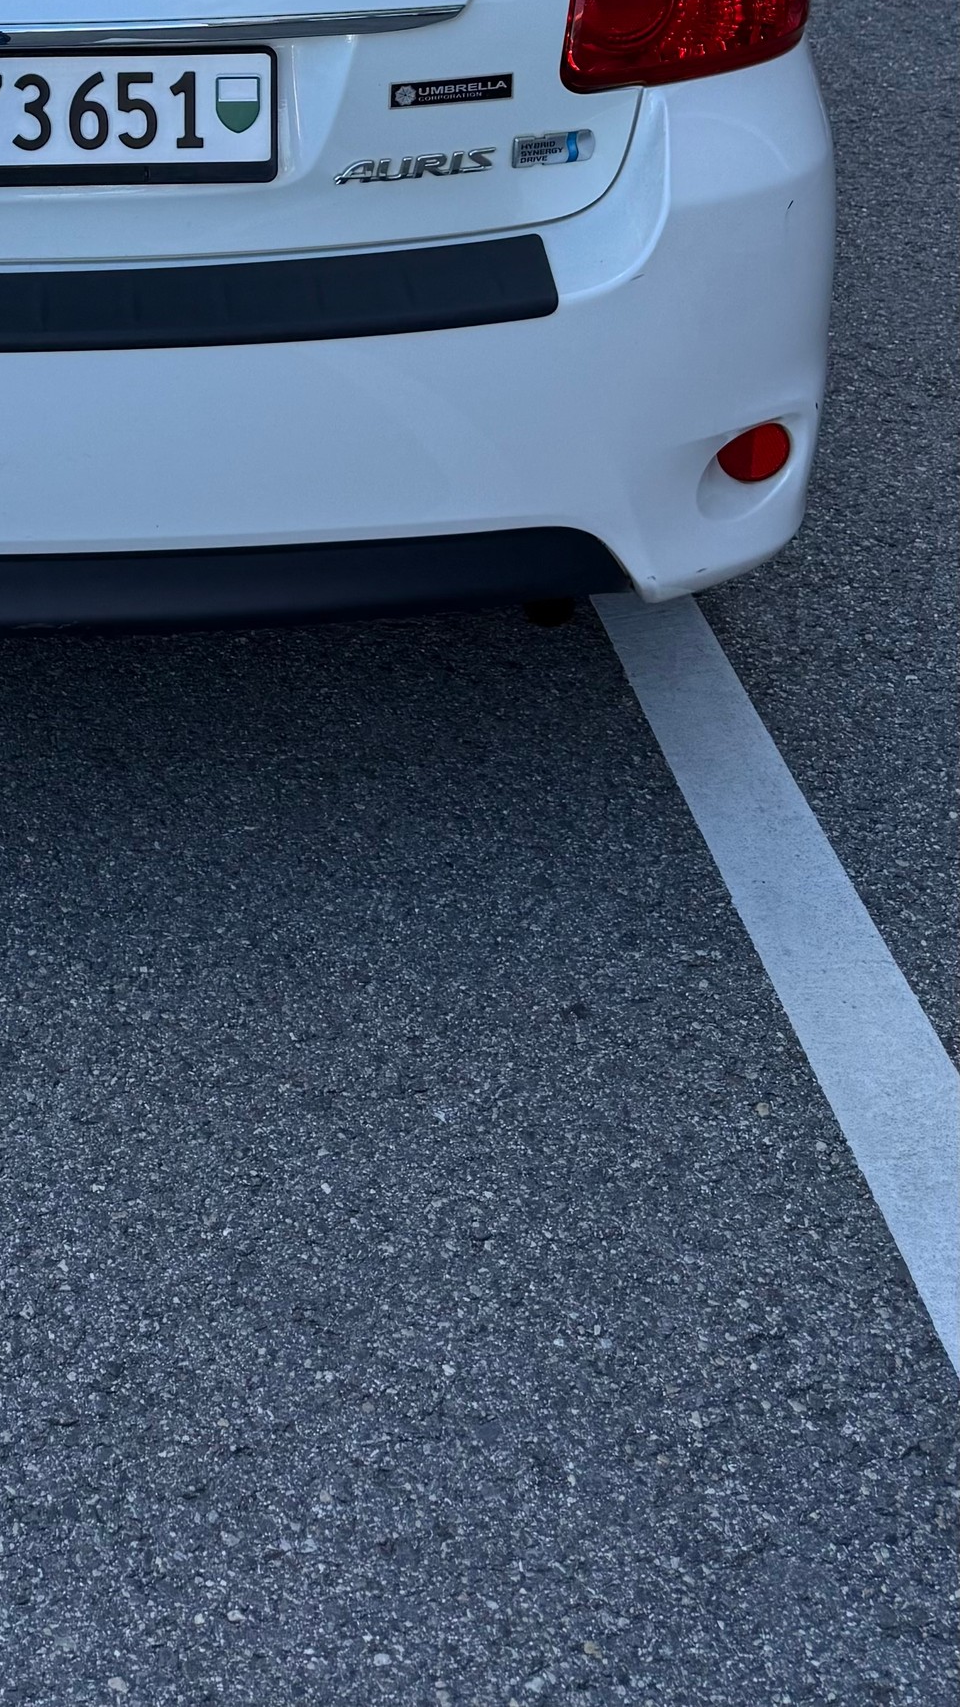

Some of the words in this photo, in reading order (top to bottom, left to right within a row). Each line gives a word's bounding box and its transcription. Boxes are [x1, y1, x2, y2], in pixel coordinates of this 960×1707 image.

[418, 80, 508, 96] UMBRELLA
[418, 91, 483, 102] CORPORATION
[521, 140, 556, 150] HYBRID
[520, 147, 563, 158] SYNERGY
[520, 155, 548, 164] DRIVE
[334, 146, 497, 185] AURIS
